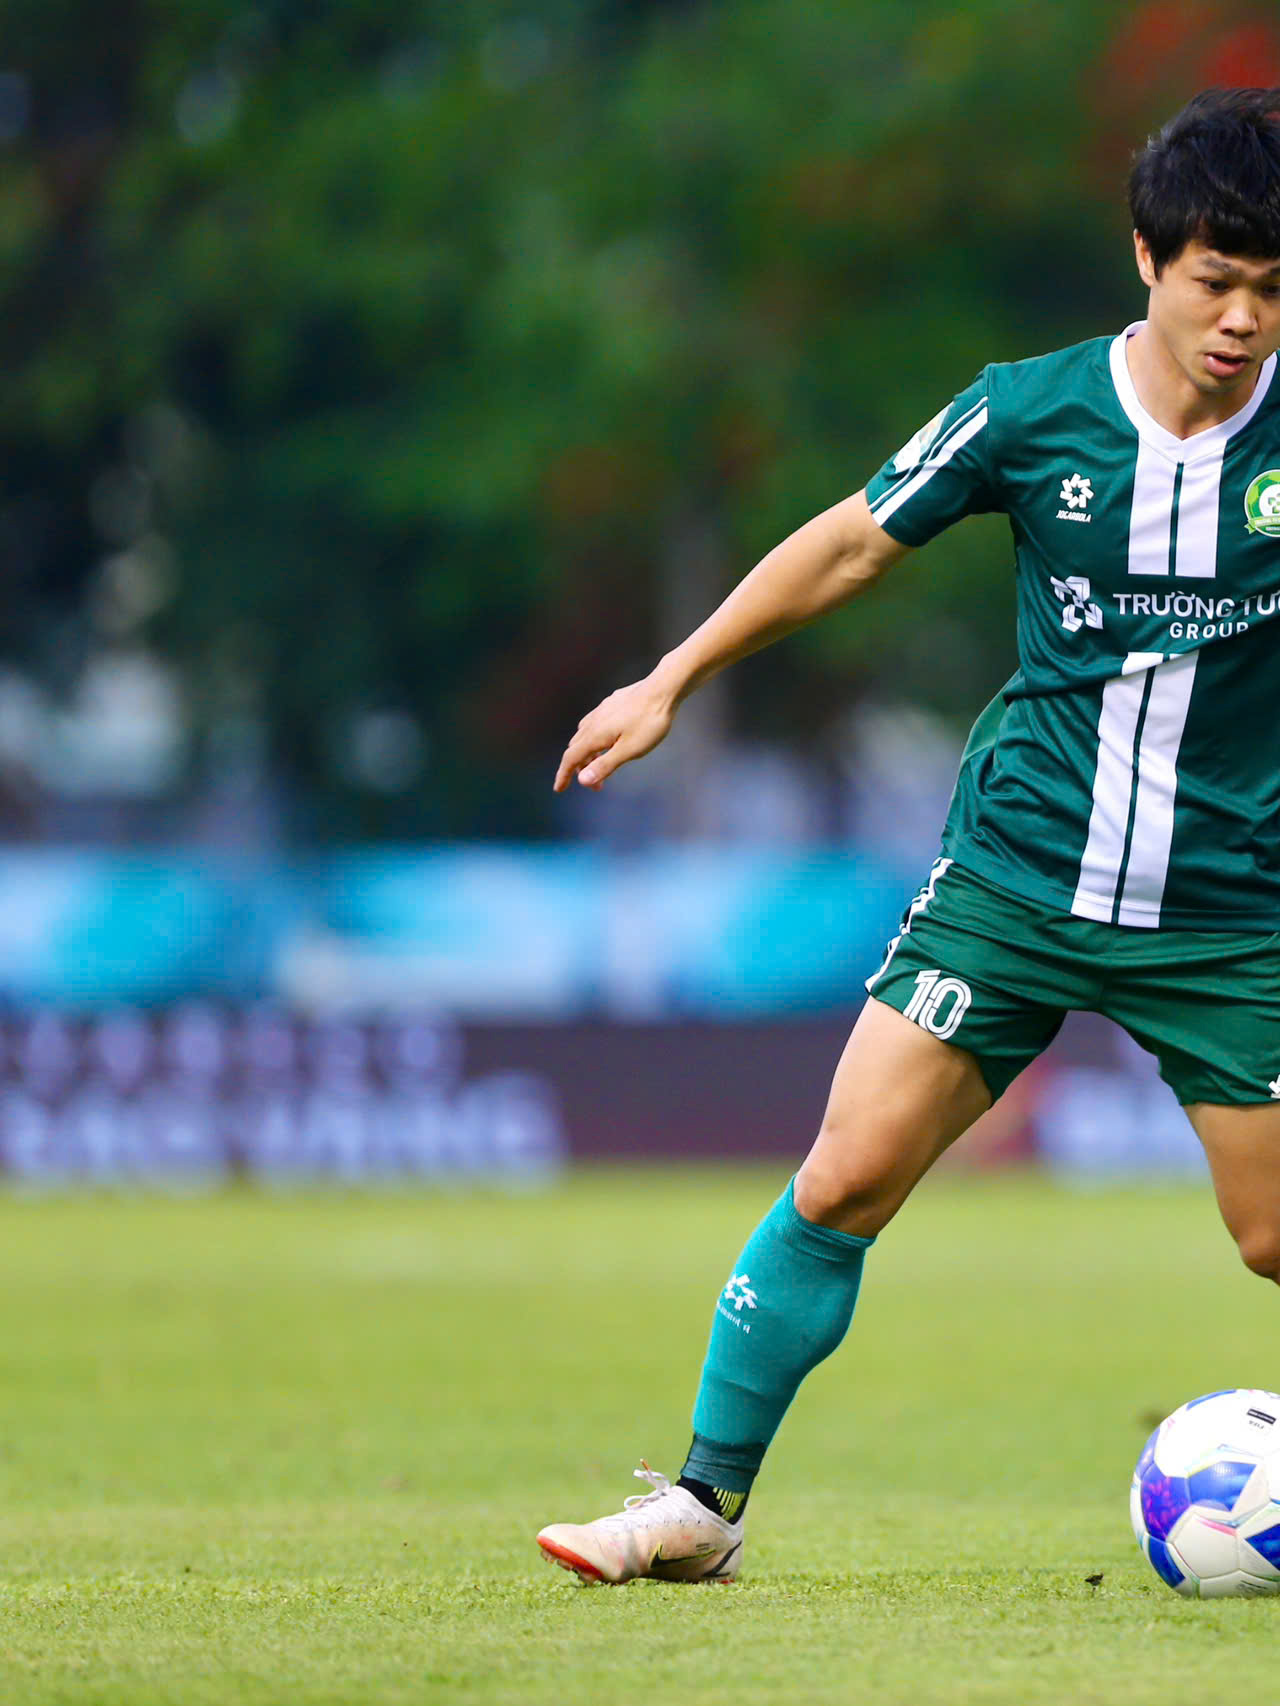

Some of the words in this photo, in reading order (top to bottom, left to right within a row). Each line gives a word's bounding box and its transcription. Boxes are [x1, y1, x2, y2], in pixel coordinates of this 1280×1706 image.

[1113, 590, 1235, 620] TRƯỜNG
[1169, 622, 1249, 640] GROUP
[903, 969, 972, 1041] 10
